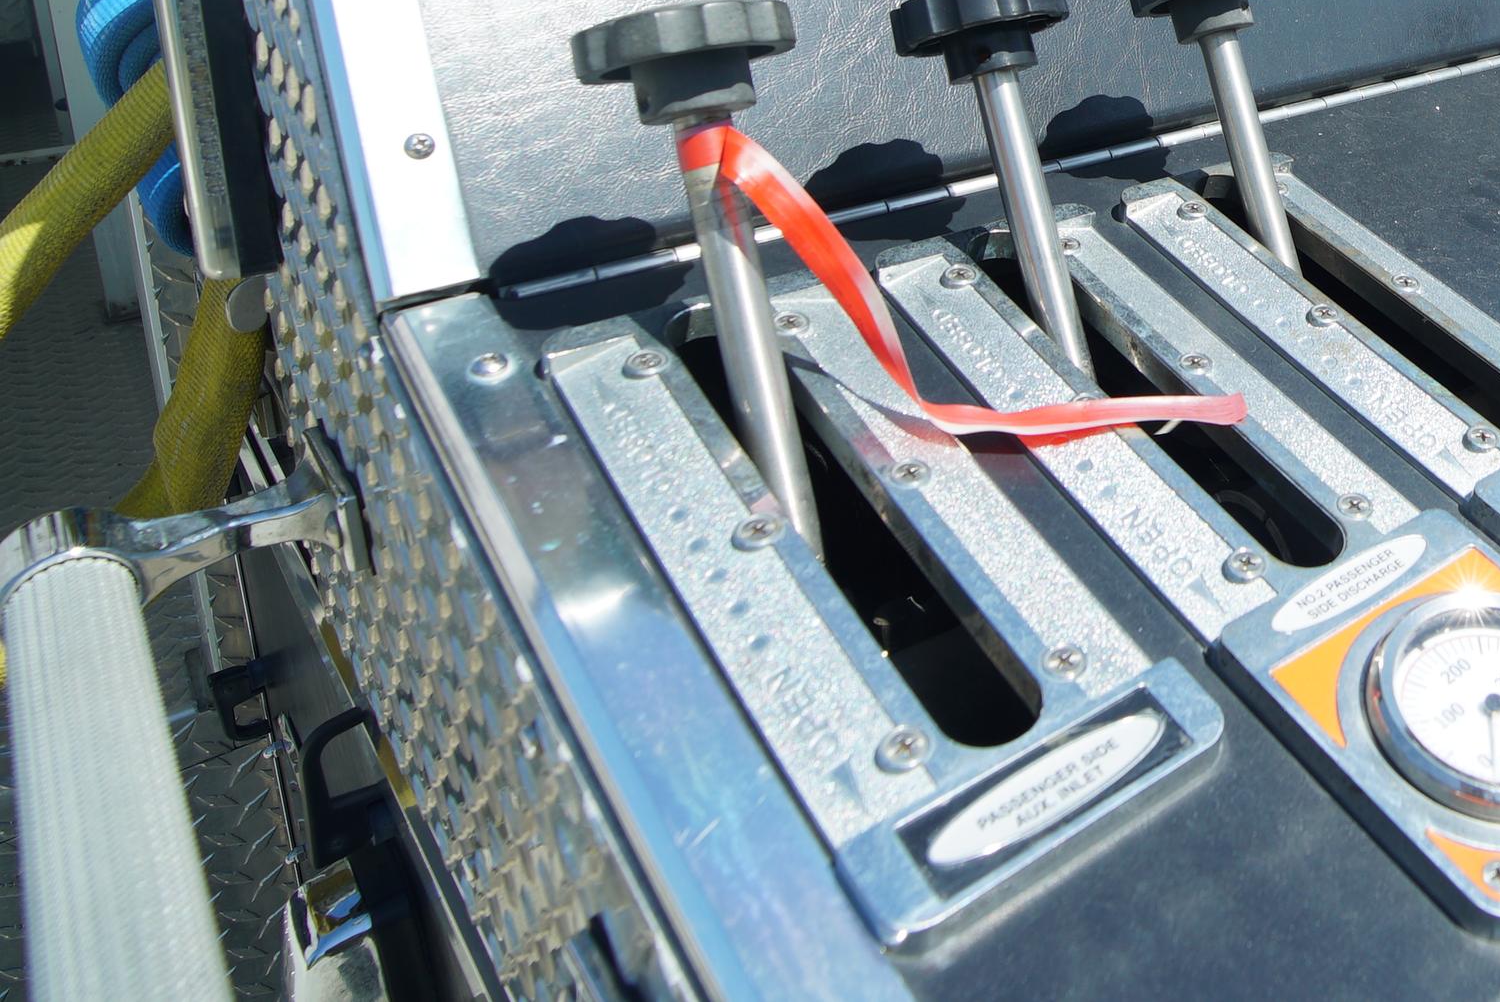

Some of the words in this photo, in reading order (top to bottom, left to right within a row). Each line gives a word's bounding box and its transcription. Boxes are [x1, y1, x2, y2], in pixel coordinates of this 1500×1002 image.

[1120, 504, 1193, 576] OPEN
[1306, 599, 1338, 620] SIDE
[1337, 558, 1405, 602] DISCHARGE
[1325, 548, 1395, 591] PASSENGER
[1440, 657, 1472, 685] 200
[764, 665, 838, 760] OPEN
[1434, 701, 1465, 730] 100
[975, 760, 1079, 830] PASSENGER
[1080, 737, 1121, 763] SIDE
[1057, 765, 1104, 800] INLET
